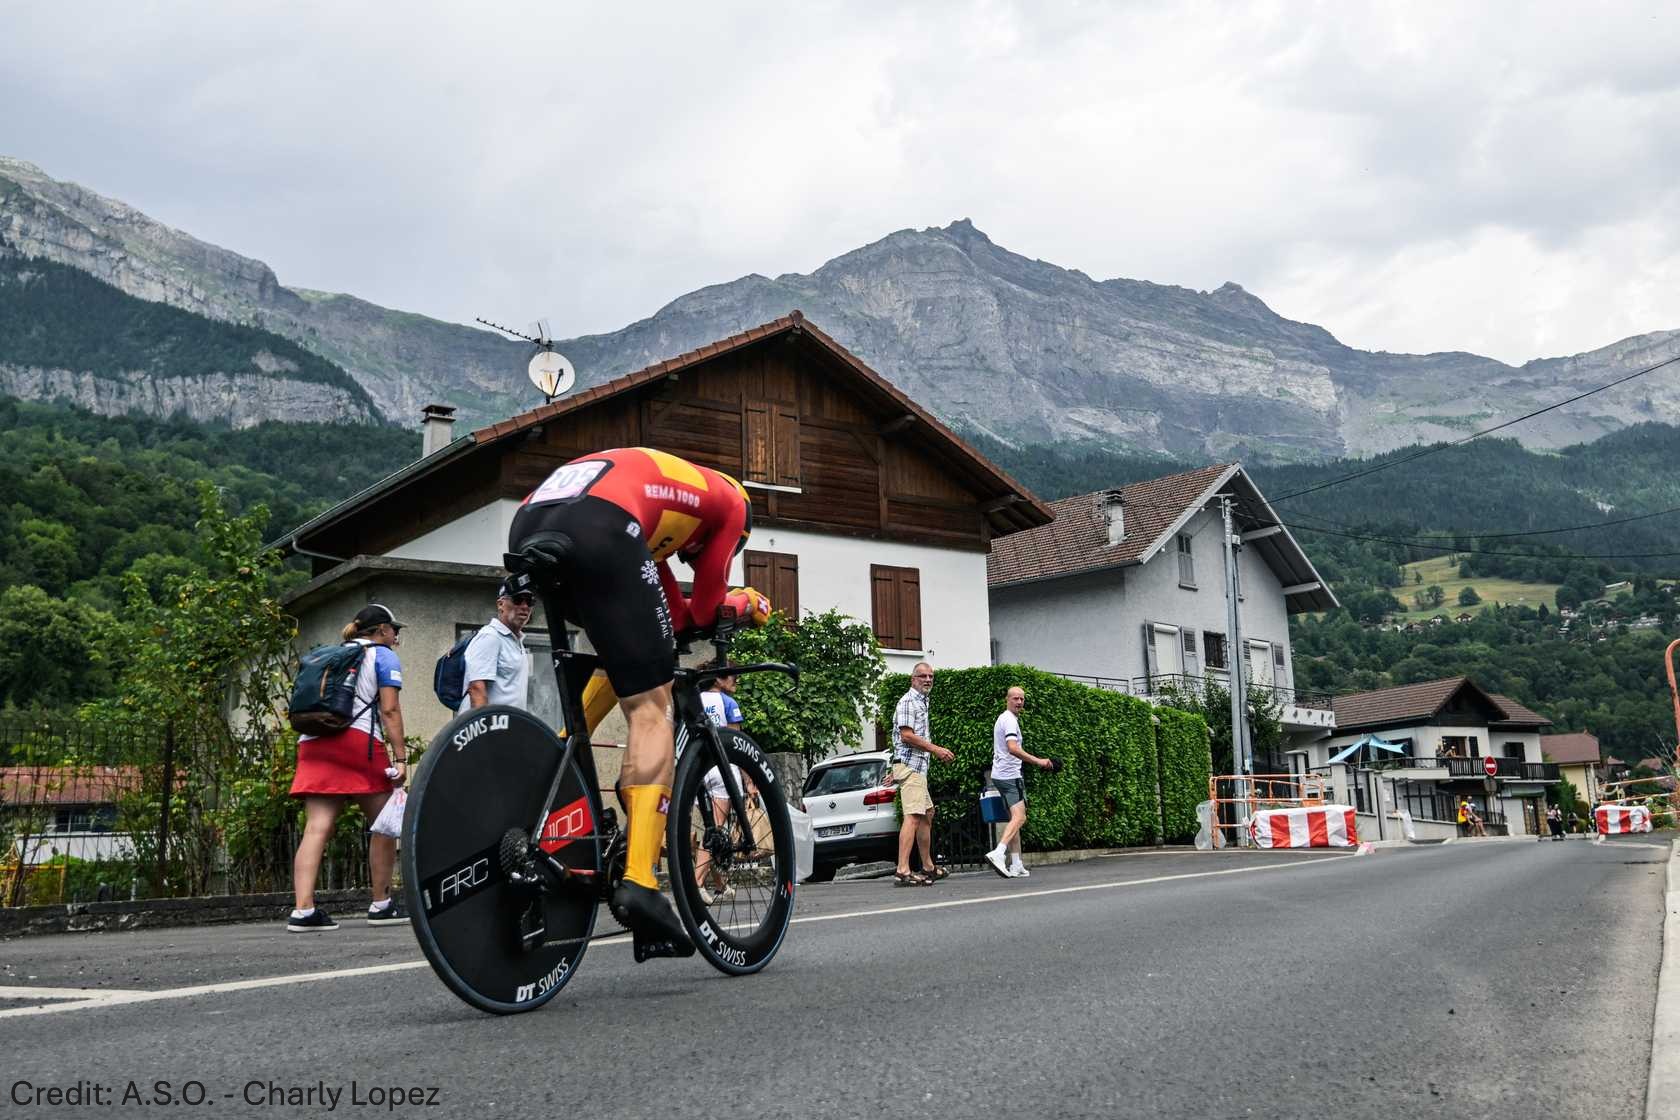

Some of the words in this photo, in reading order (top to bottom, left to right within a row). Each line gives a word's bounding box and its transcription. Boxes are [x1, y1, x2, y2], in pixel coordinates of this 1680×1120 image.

[644, 484, 675, 501] REMA
[676, 489, 700, 507] 1000
[655, 606, 670, 639] RETAIL
[453, 717, 488, 751] SWISS
[489, 714, 510, 731] DT
[732, 736, 761, 762] SWISS
[759, 761, 775, 783] DT
[440, 857, 489, 903] ARC
[697, 919, 718, 945] DT
[716, 941, 746, 967] SWISS
[515, 982, 537, 1003] DT
[538, 956, 569, 995] SWISS
